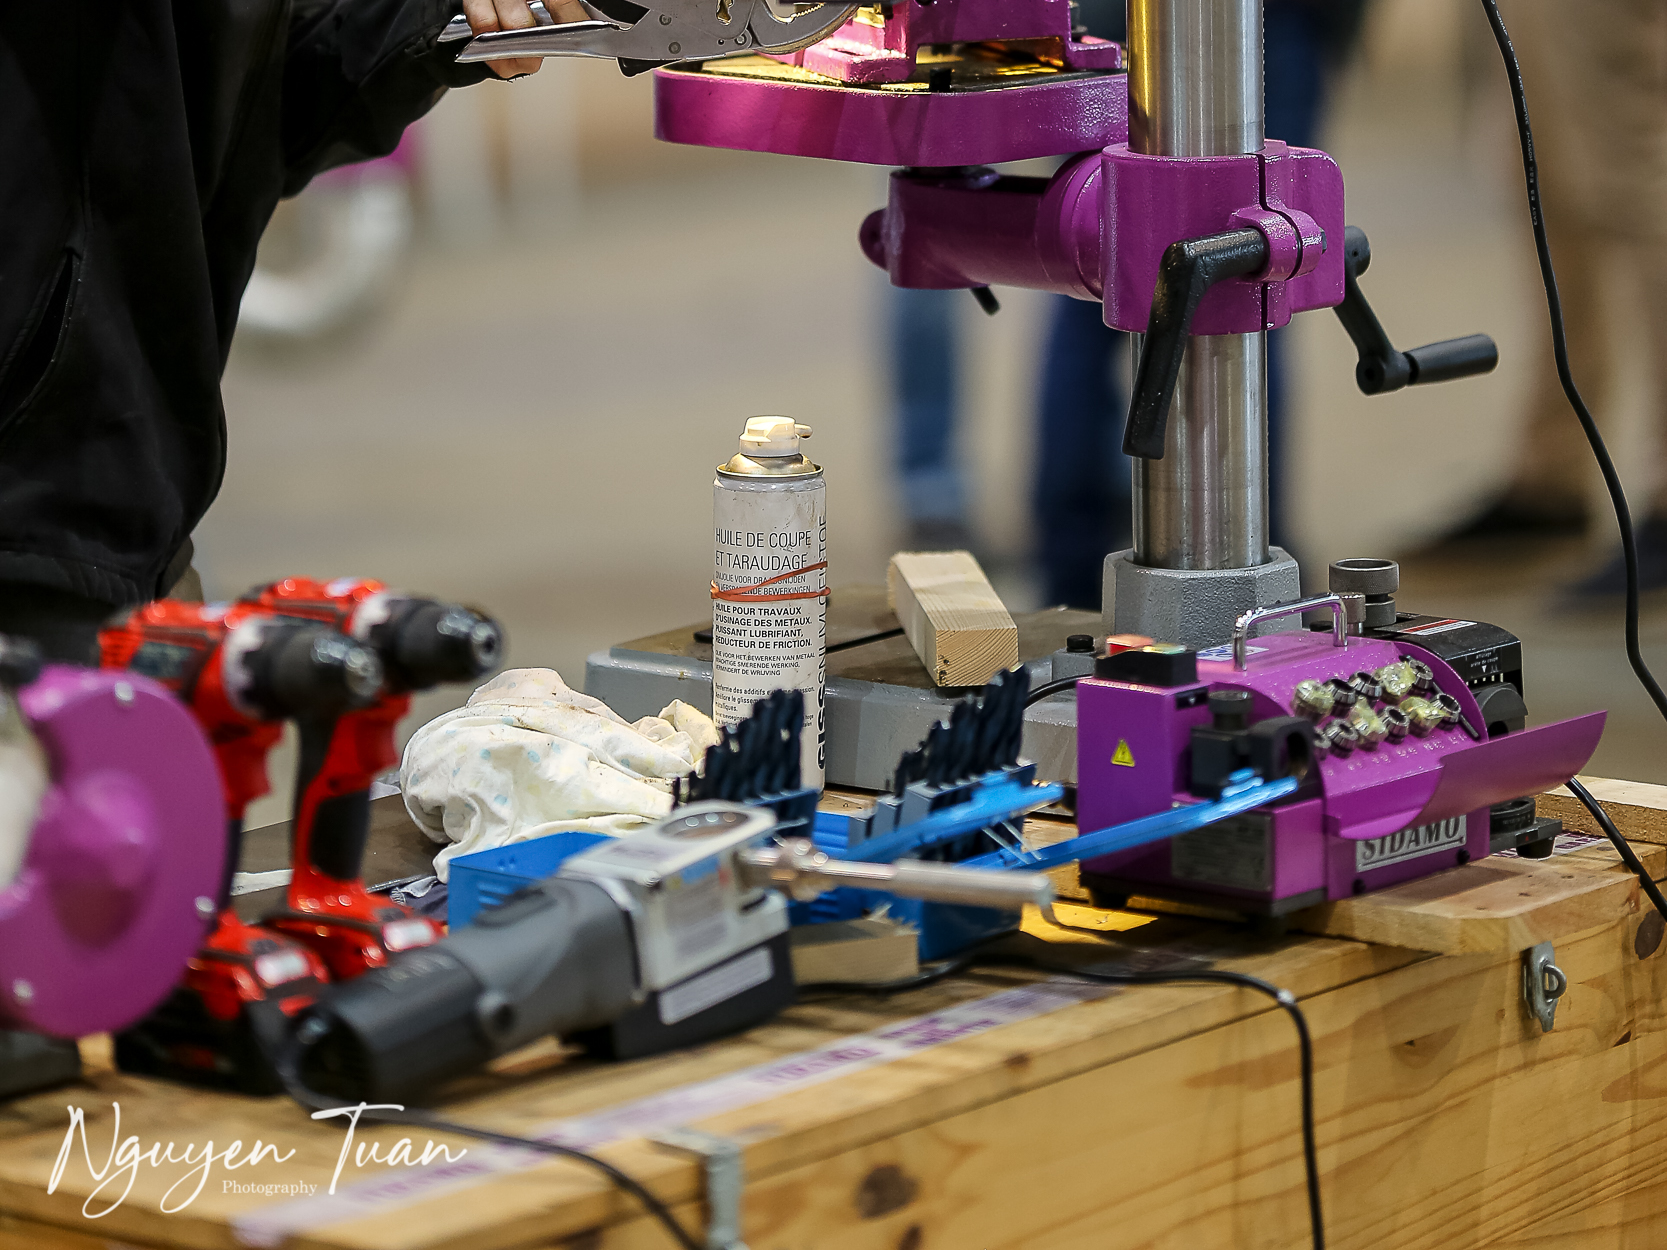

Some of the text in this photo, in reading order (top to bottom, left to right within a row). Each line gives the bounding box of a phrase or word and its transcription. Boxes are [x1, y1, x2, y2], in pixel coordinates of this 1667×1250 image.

[716, 528, 811, 547] HUILE DE COUPE
[716, 551, 808, 570] ET TARAUDAGE
[735, 575, 751, 584] VOOR
[716, 602, 801, 616] HUILE POUR TRAVAUX
[716, 614, 751, 626] D'USINAGE
[716, 625, 803, 637] PUISSANT LUBRIFIANT,
[773, 639, 812, 648] FRICTION.
[1362, 816, 1460, 860] SIDAMO
